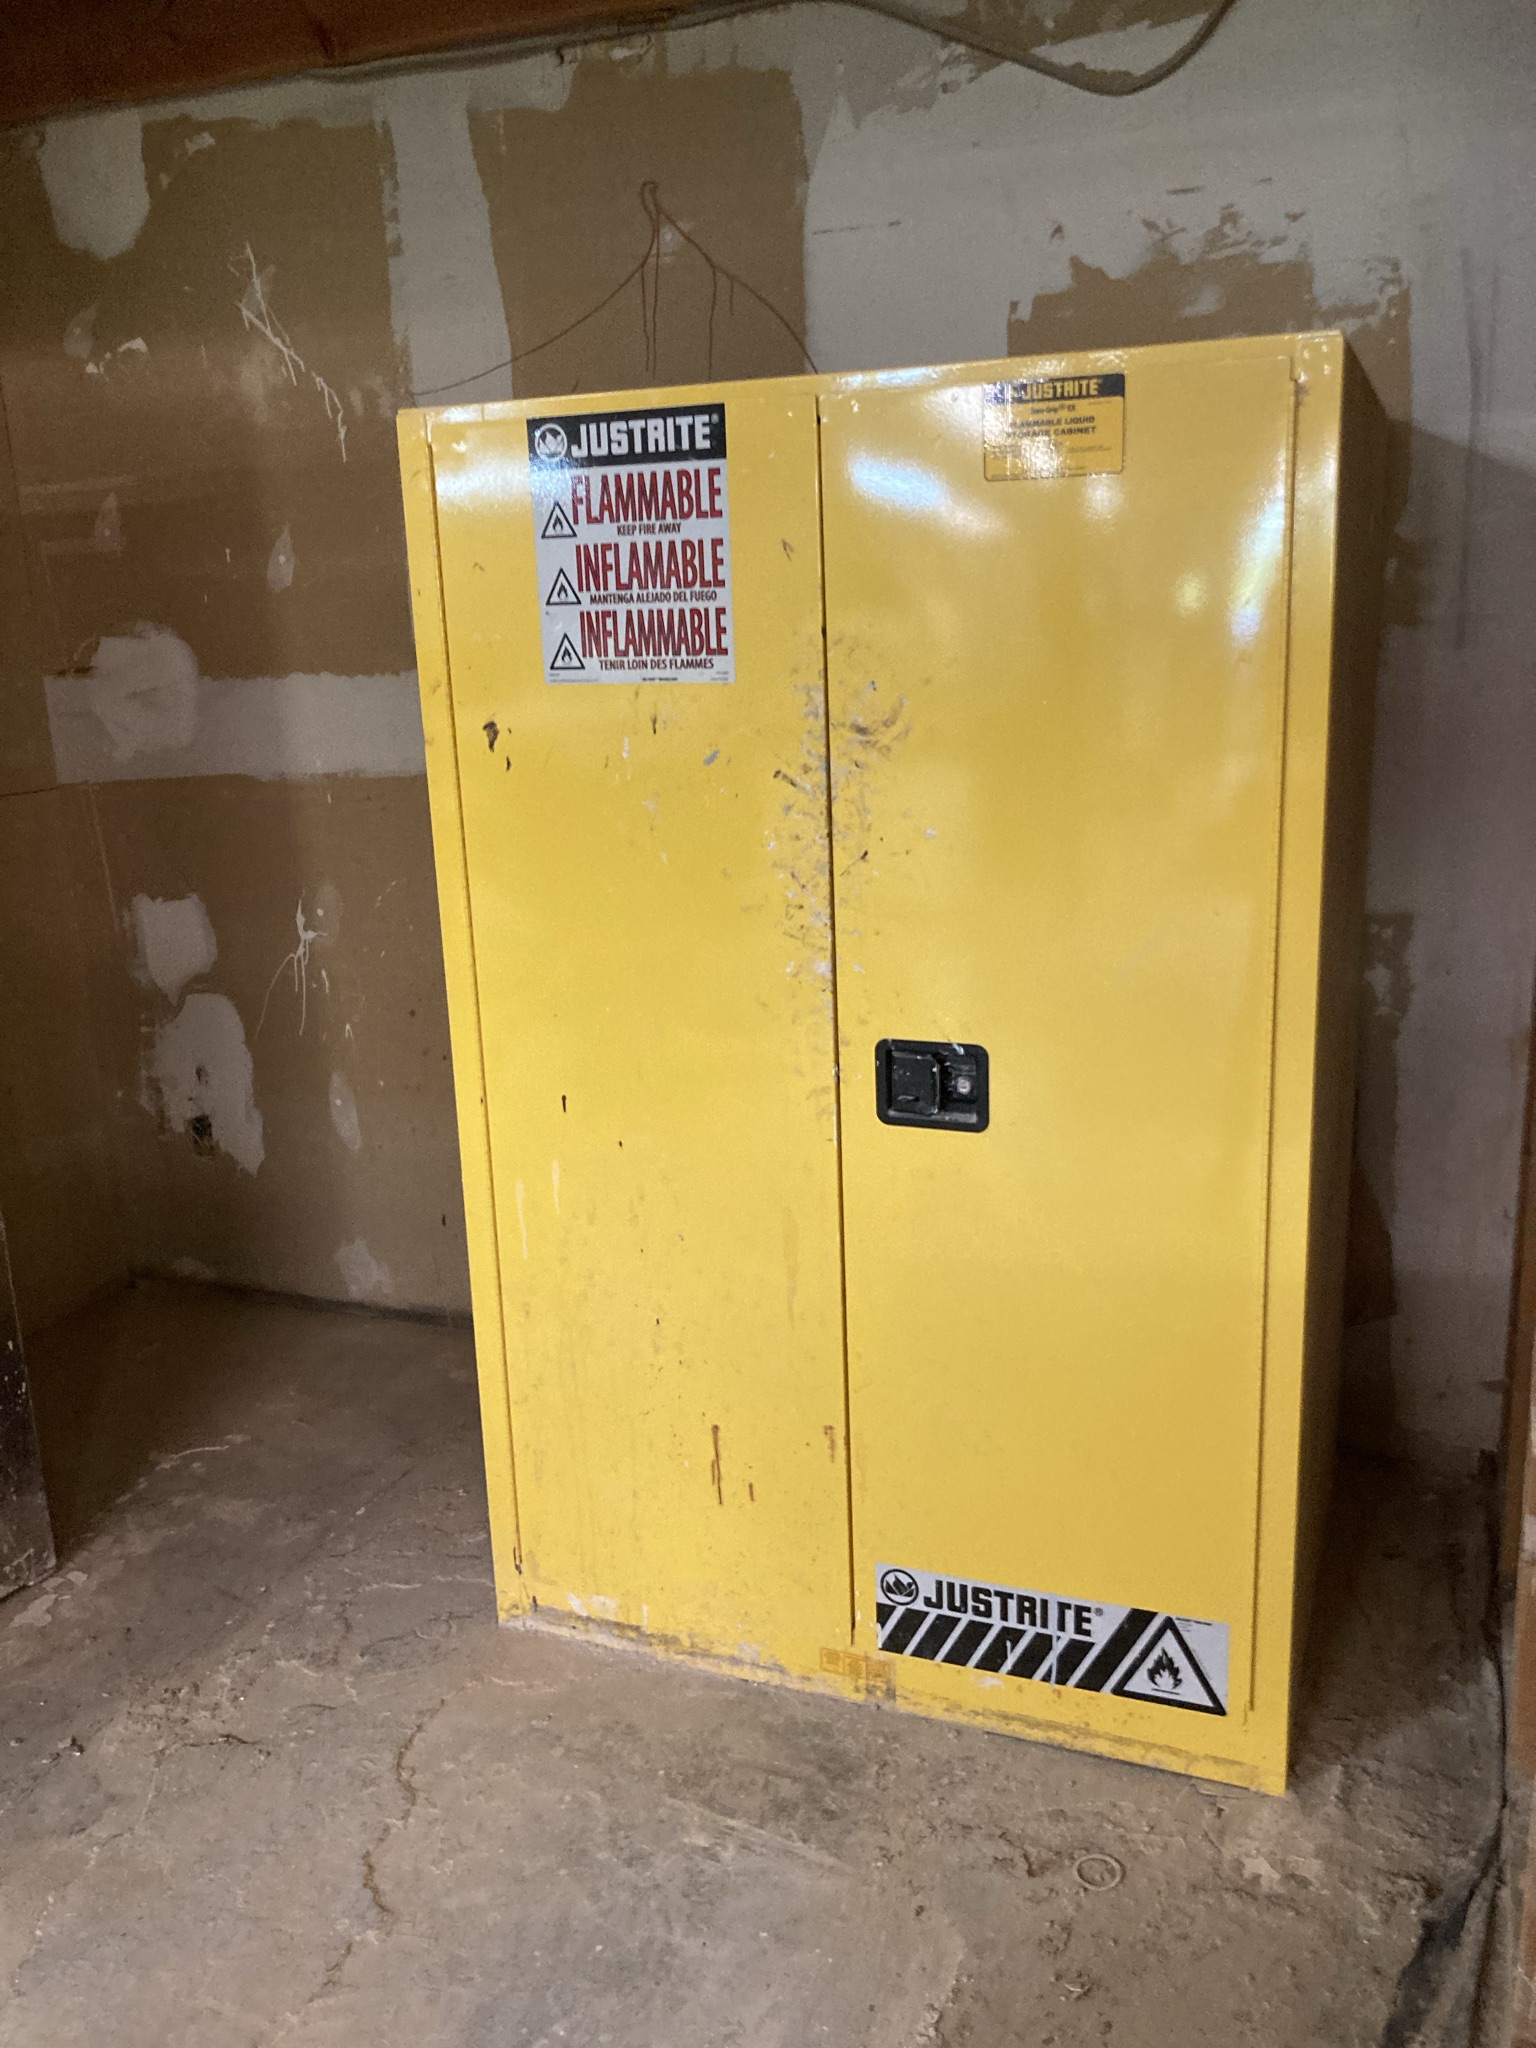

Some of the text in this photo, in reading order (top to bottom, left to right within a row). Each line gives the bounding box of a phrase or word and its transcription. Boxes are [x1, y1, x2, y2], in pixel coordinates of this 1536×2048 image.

[1053, 426, 1096, 437] CABINET
[571, 467, 723, 525] FLAMMABLE
[617, 522, 681, 536] KEEP FIRE AWAY
[575, 538, 725, 592] INFLAMABLE
[590, 590, 717, 605] MANTENGA ALEJADO DEL FUEGO
[579, 607, 729, 658] INFLAMMABLE
[599, 658, 714, 671] TENIR LOIN DES FLAMMES
